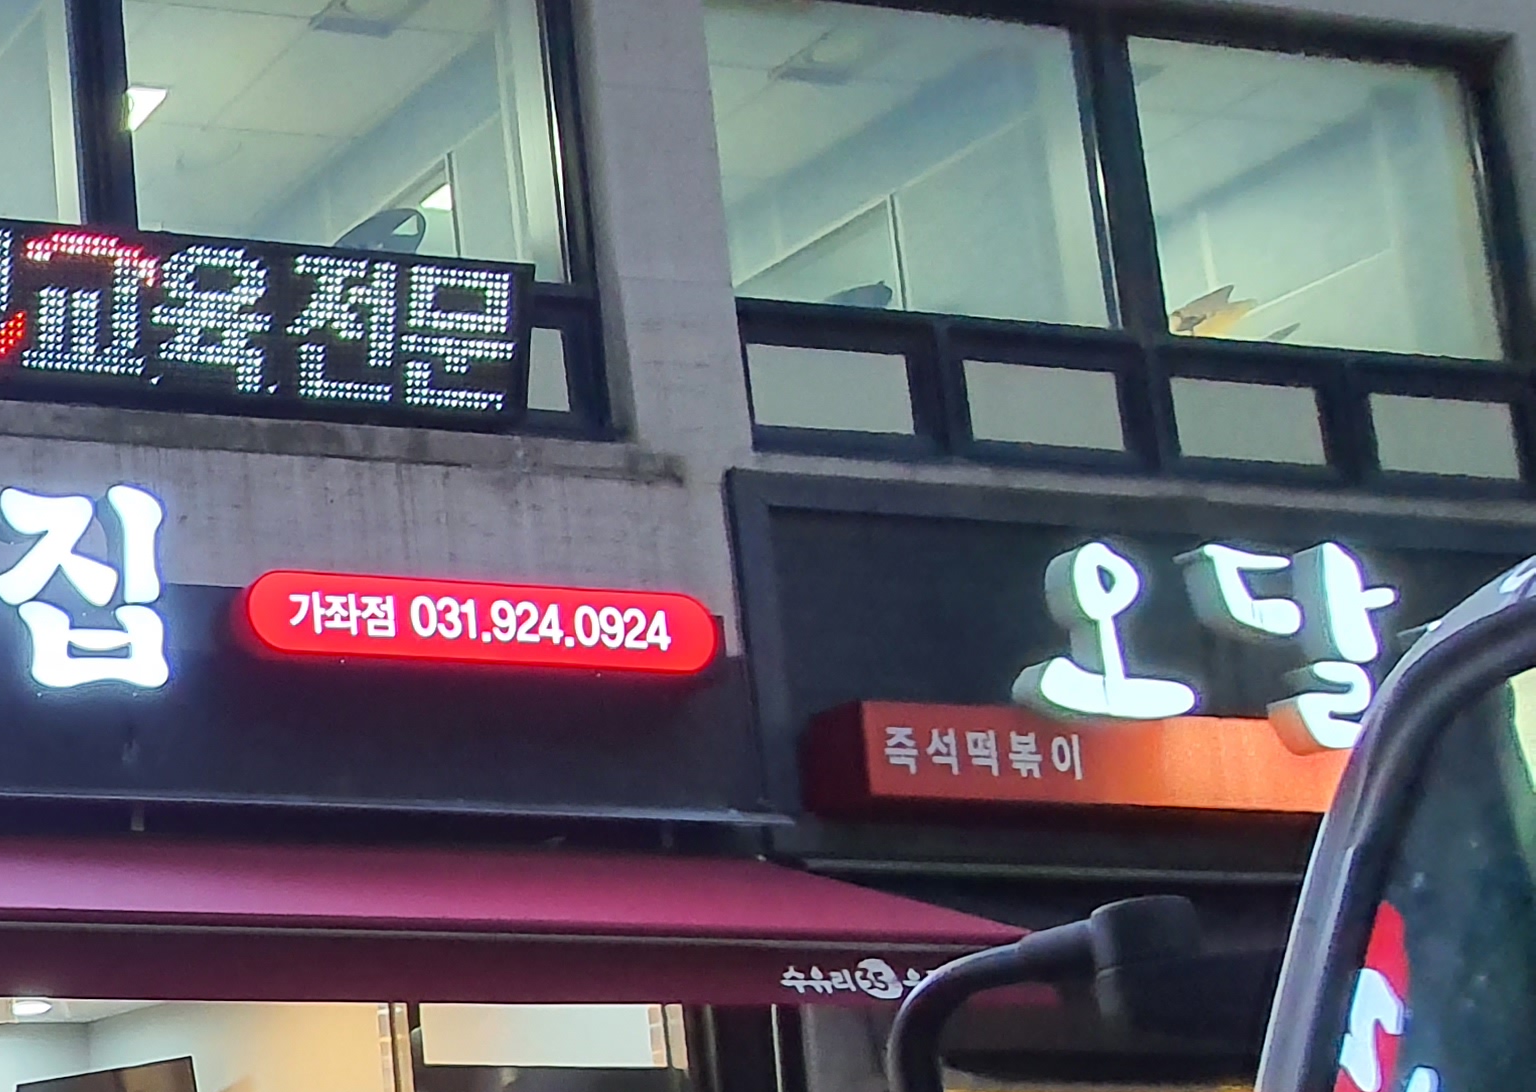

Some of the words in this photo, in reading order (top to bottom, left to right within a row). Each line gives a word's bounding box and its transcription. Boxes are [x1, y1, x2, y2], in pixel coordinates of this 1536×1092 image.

[285, 254, 517, 412] 전문
[289, 591, 396, 637] 가좌점
[410, 595, 672, 651] 031.924.0924
[883, 727, 1084, 780] 즉석떡볶이
[780, 965, 856, 994] 수유리
